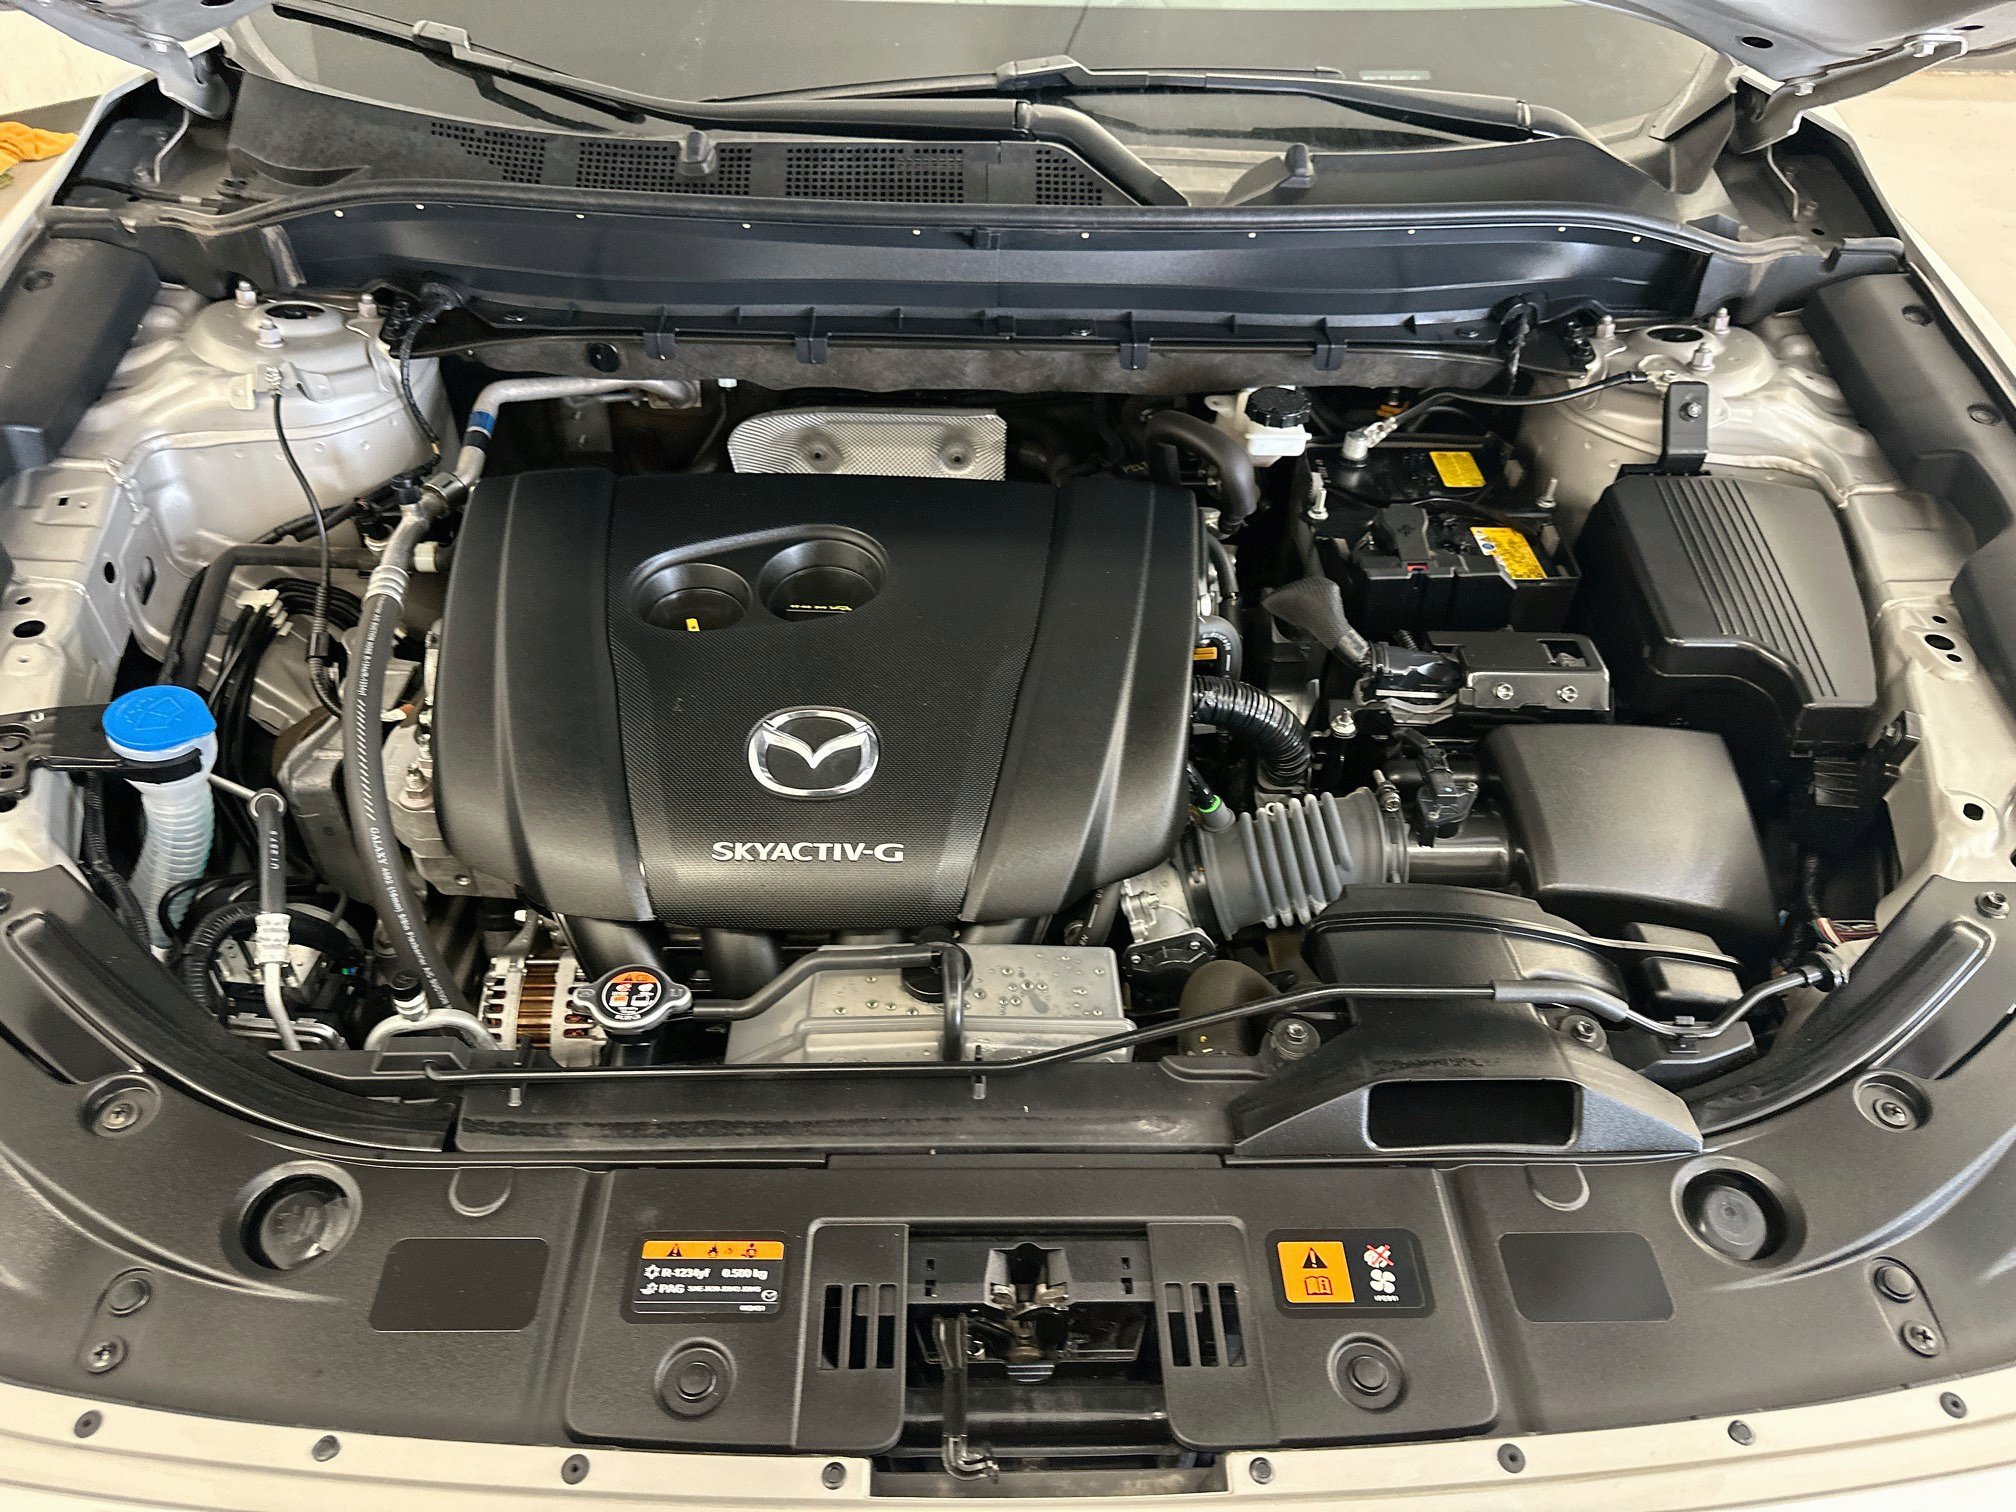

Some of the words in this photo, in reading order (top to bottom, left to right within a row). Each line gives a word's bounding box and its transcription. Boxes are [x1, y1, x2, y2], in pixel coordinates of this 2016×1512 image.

[369, 827, 388, 865] GALAXY
[711, 841, 904, 862] SKYACTIV-G
[661, 1267, 711, 1280] R-1234yf
[753, 1268, 769, 1280] kg
[658, 1283, 686, 1294] PAG
